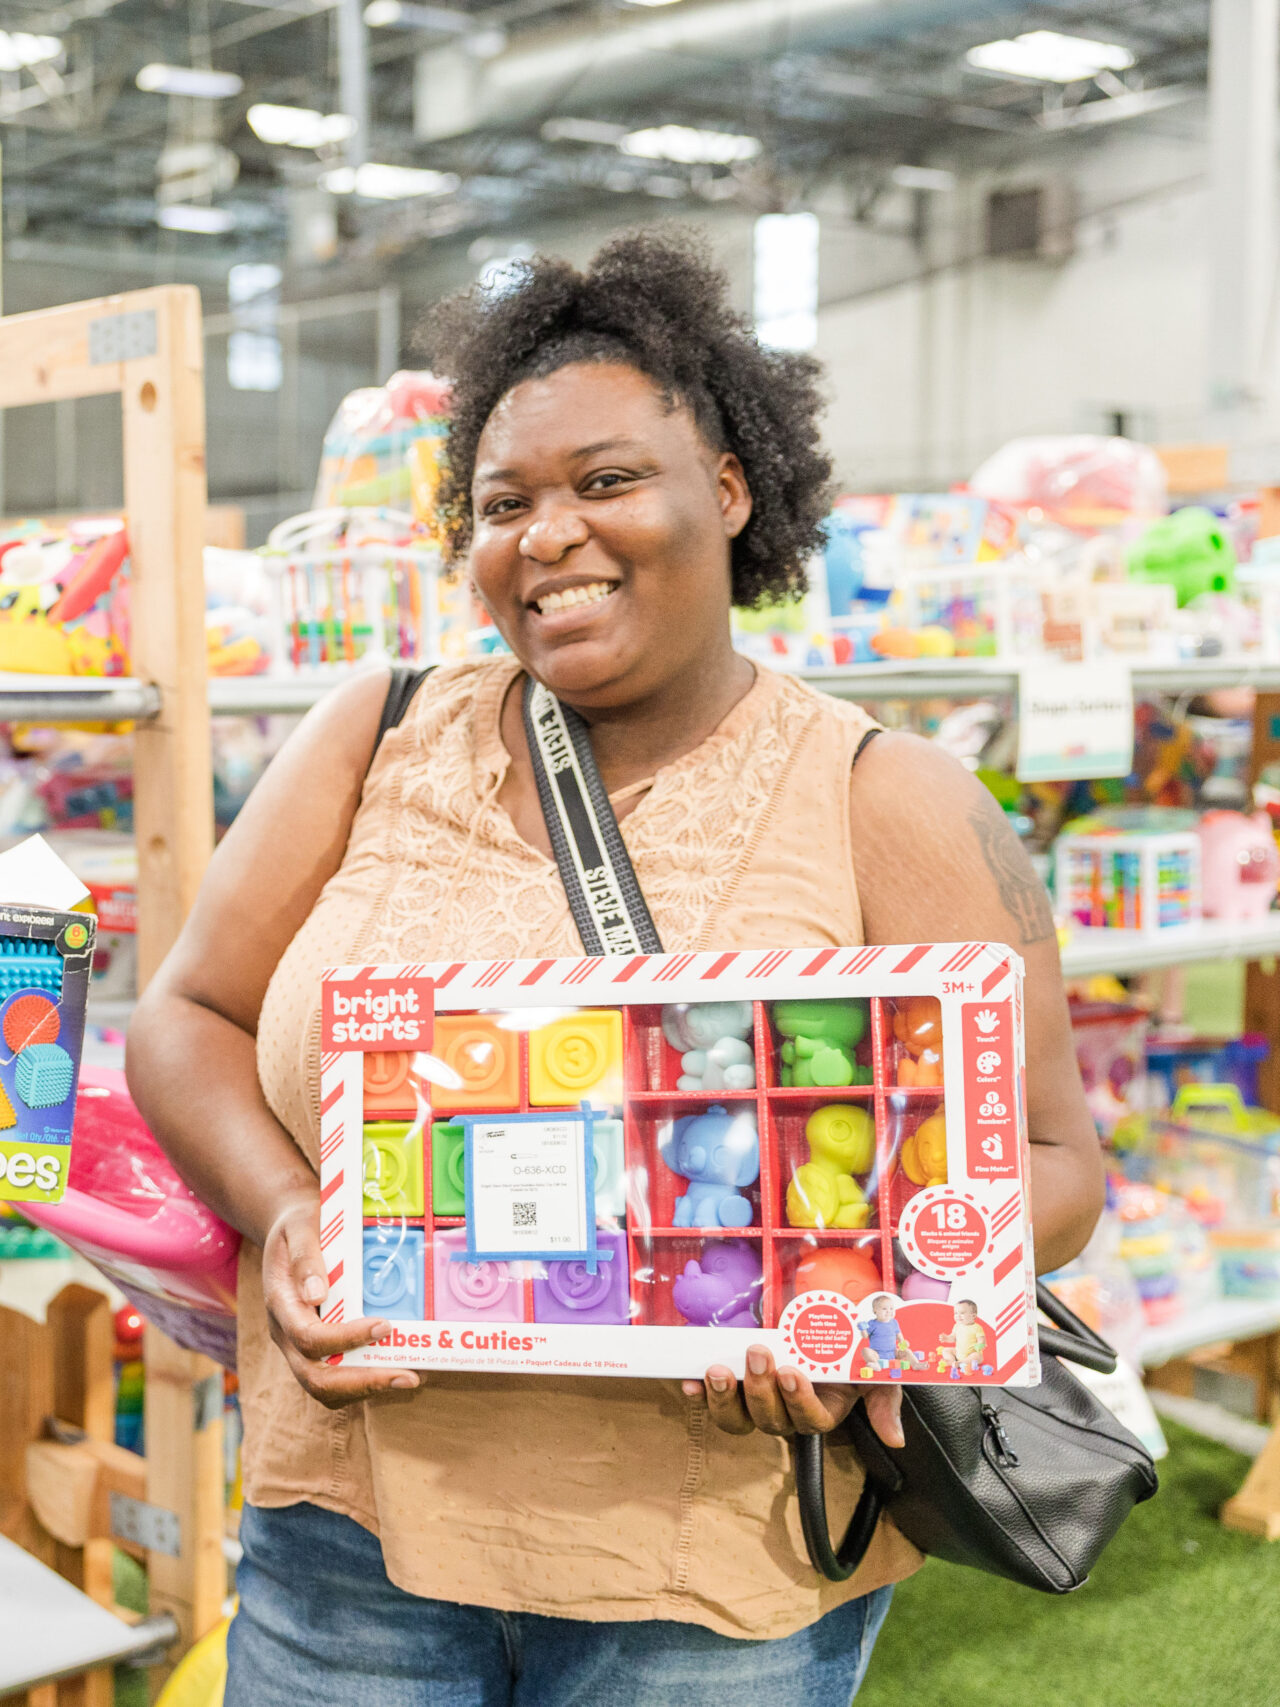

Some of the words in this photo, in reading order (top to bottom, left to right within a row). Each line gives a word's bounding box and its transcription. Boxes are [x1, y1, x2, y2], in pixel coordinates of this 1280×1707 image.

[584, 866, 623, 921] STEVE
[942, 981, 975, 994] 3M+
[333, 988, 420, 1022] bright
[931, 1203, 967, 1230] 18
[438, 1330, 454, 1348] &
[525, 1358, 552, 1368] Paquet
[553, 1359, 581, 1367] Cadeau
[594, 1360, 602, 1368] 18
